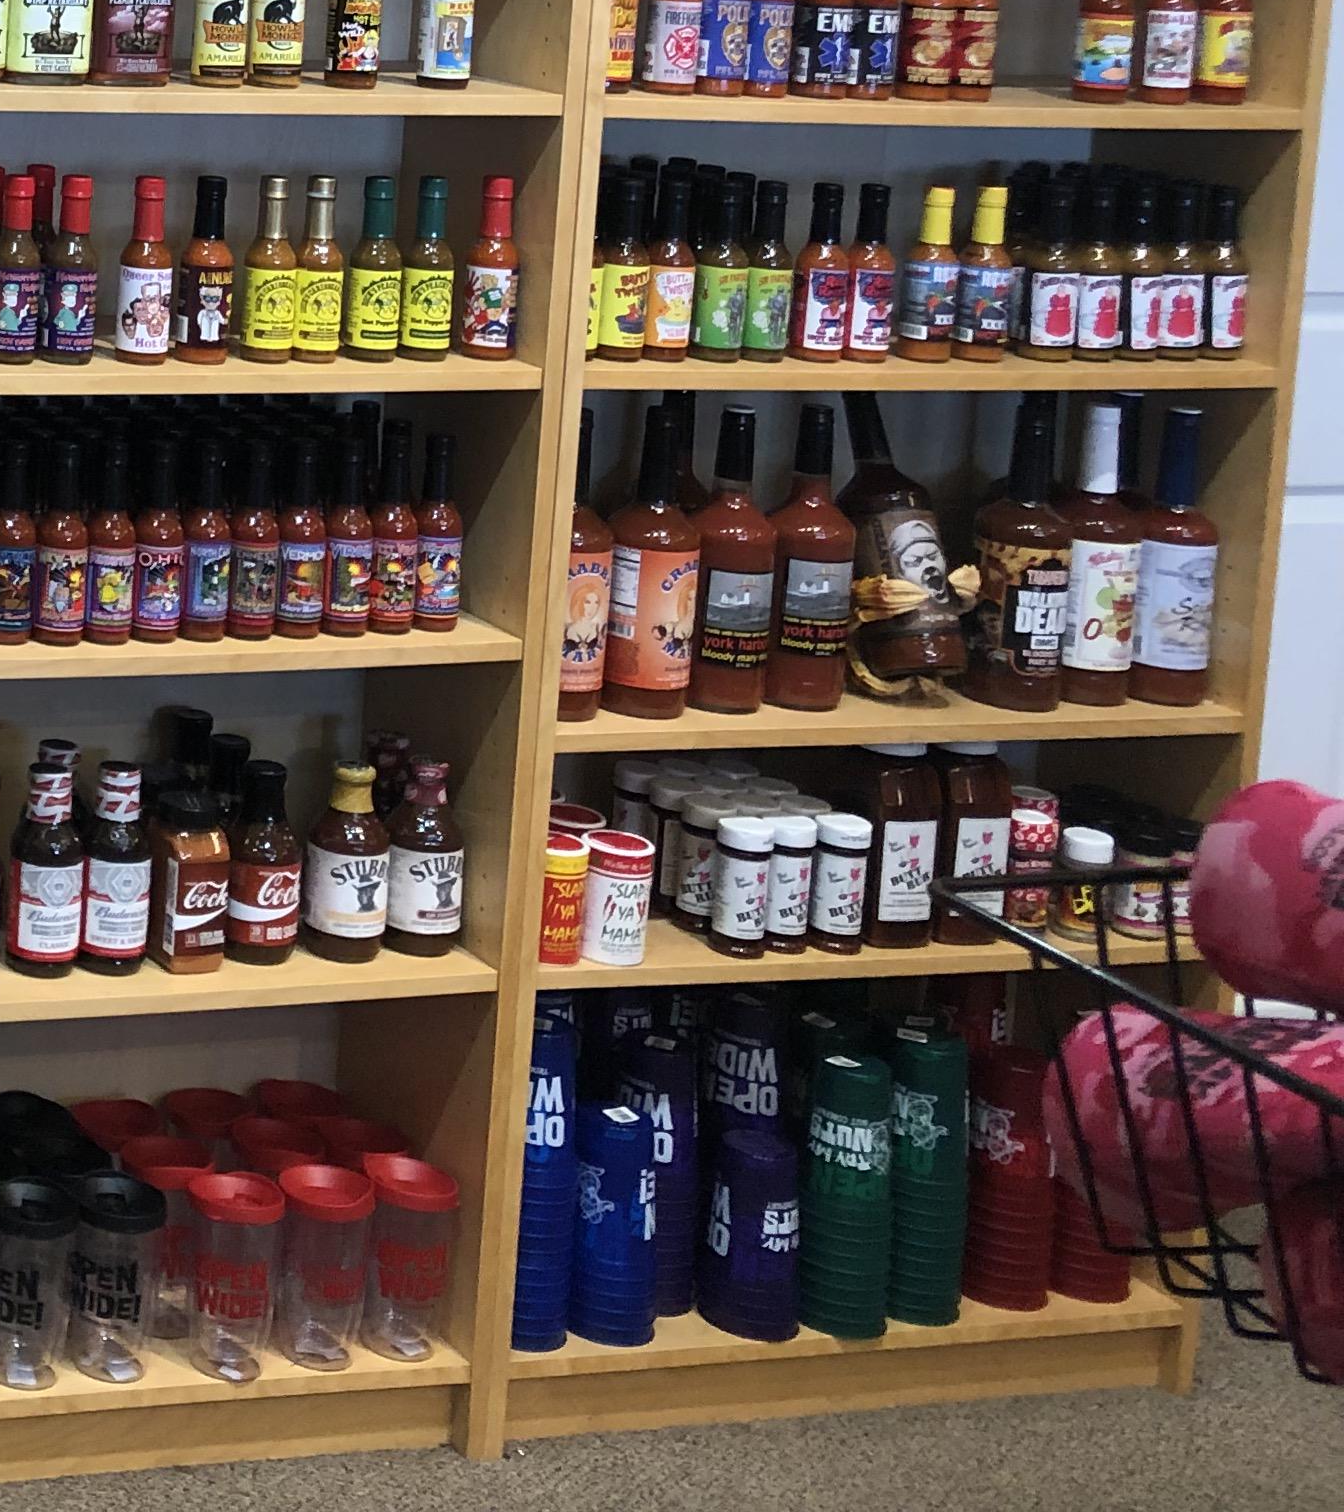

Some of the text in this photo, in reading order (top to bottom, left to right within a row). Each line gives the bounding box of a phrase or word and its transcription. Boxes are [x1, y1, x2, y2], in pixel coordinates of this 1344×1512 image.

[281, 542, 324, 560] VERMO
[783, 624, 848, 638] york harb
[703, 636, 767, 650] york harb
[781, 638, 814, 651] bloody
[701, 648, 735, 662] bloody
[330, 855, 387, 885] STUBB
[561, 905, 575, 919] YA
[618, 906, 634, 919] YA
